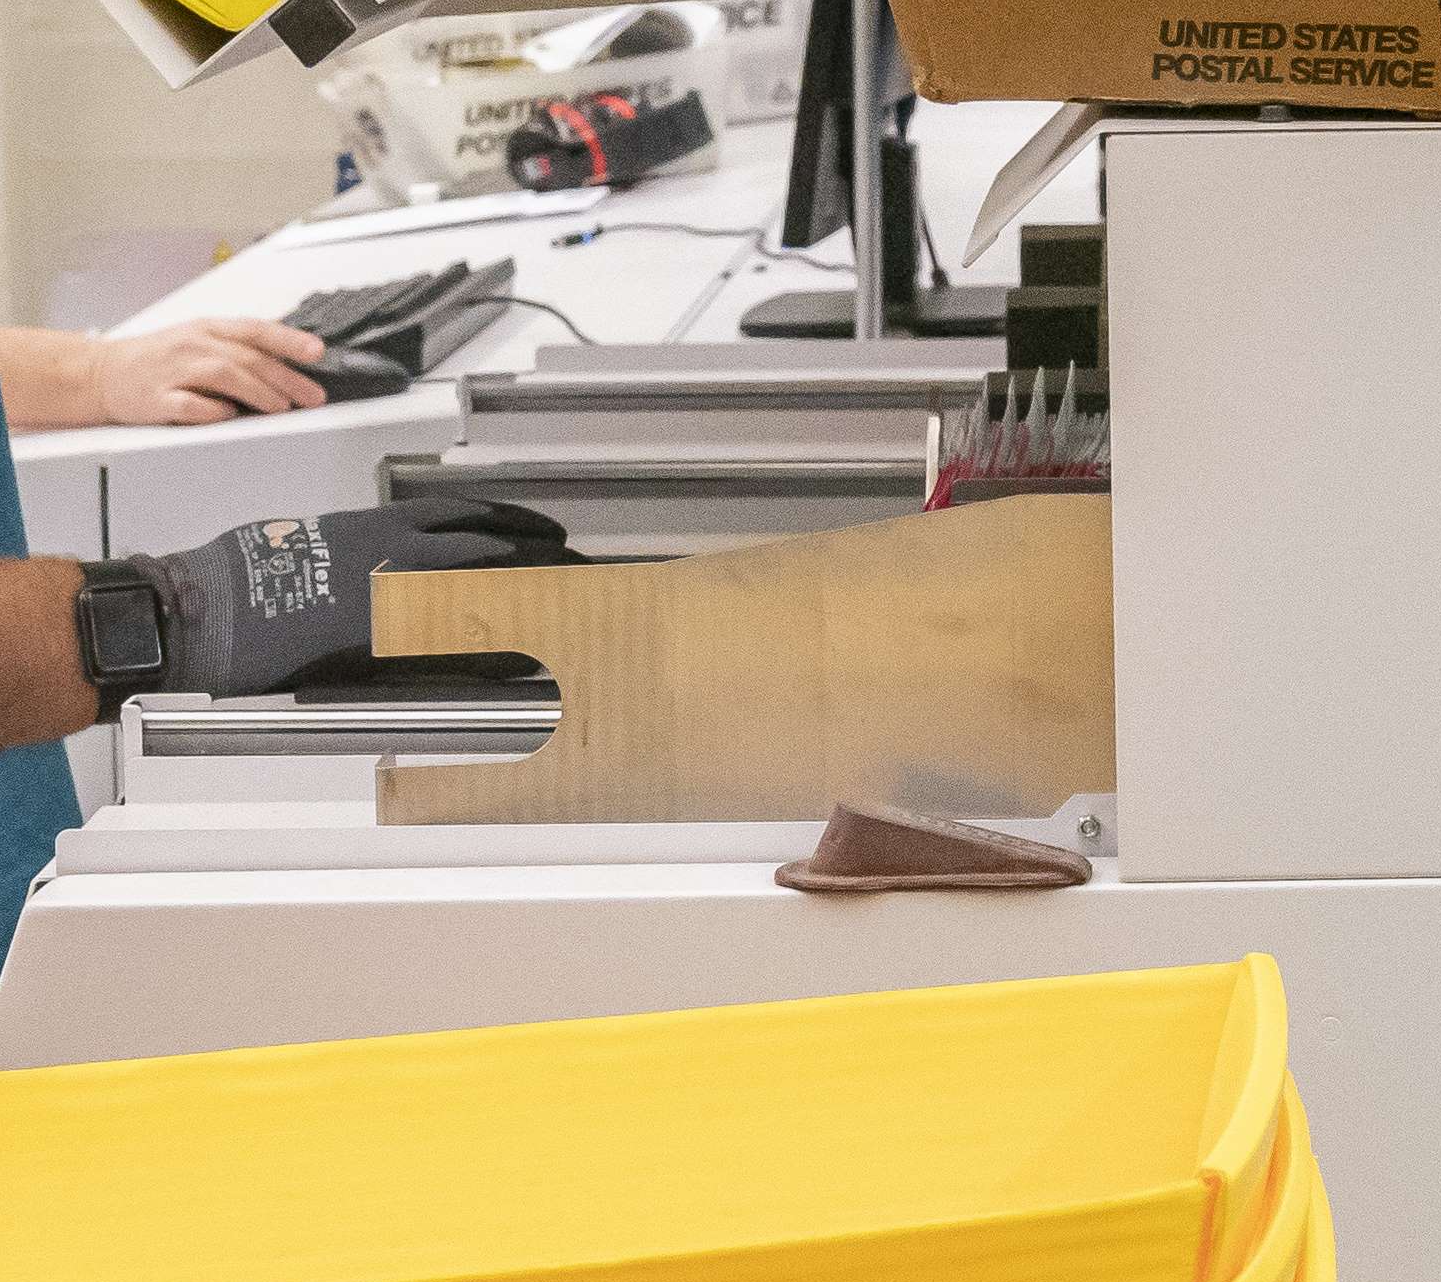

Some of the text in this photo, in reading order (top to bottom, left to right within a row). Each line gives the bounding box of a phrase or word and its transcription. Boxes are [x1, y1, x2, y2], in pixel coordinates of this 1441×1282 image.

[1159, 20, 1422, 55] UNITED STATES
[1152, 53, 1437, 89] POSTAL SERVICE
